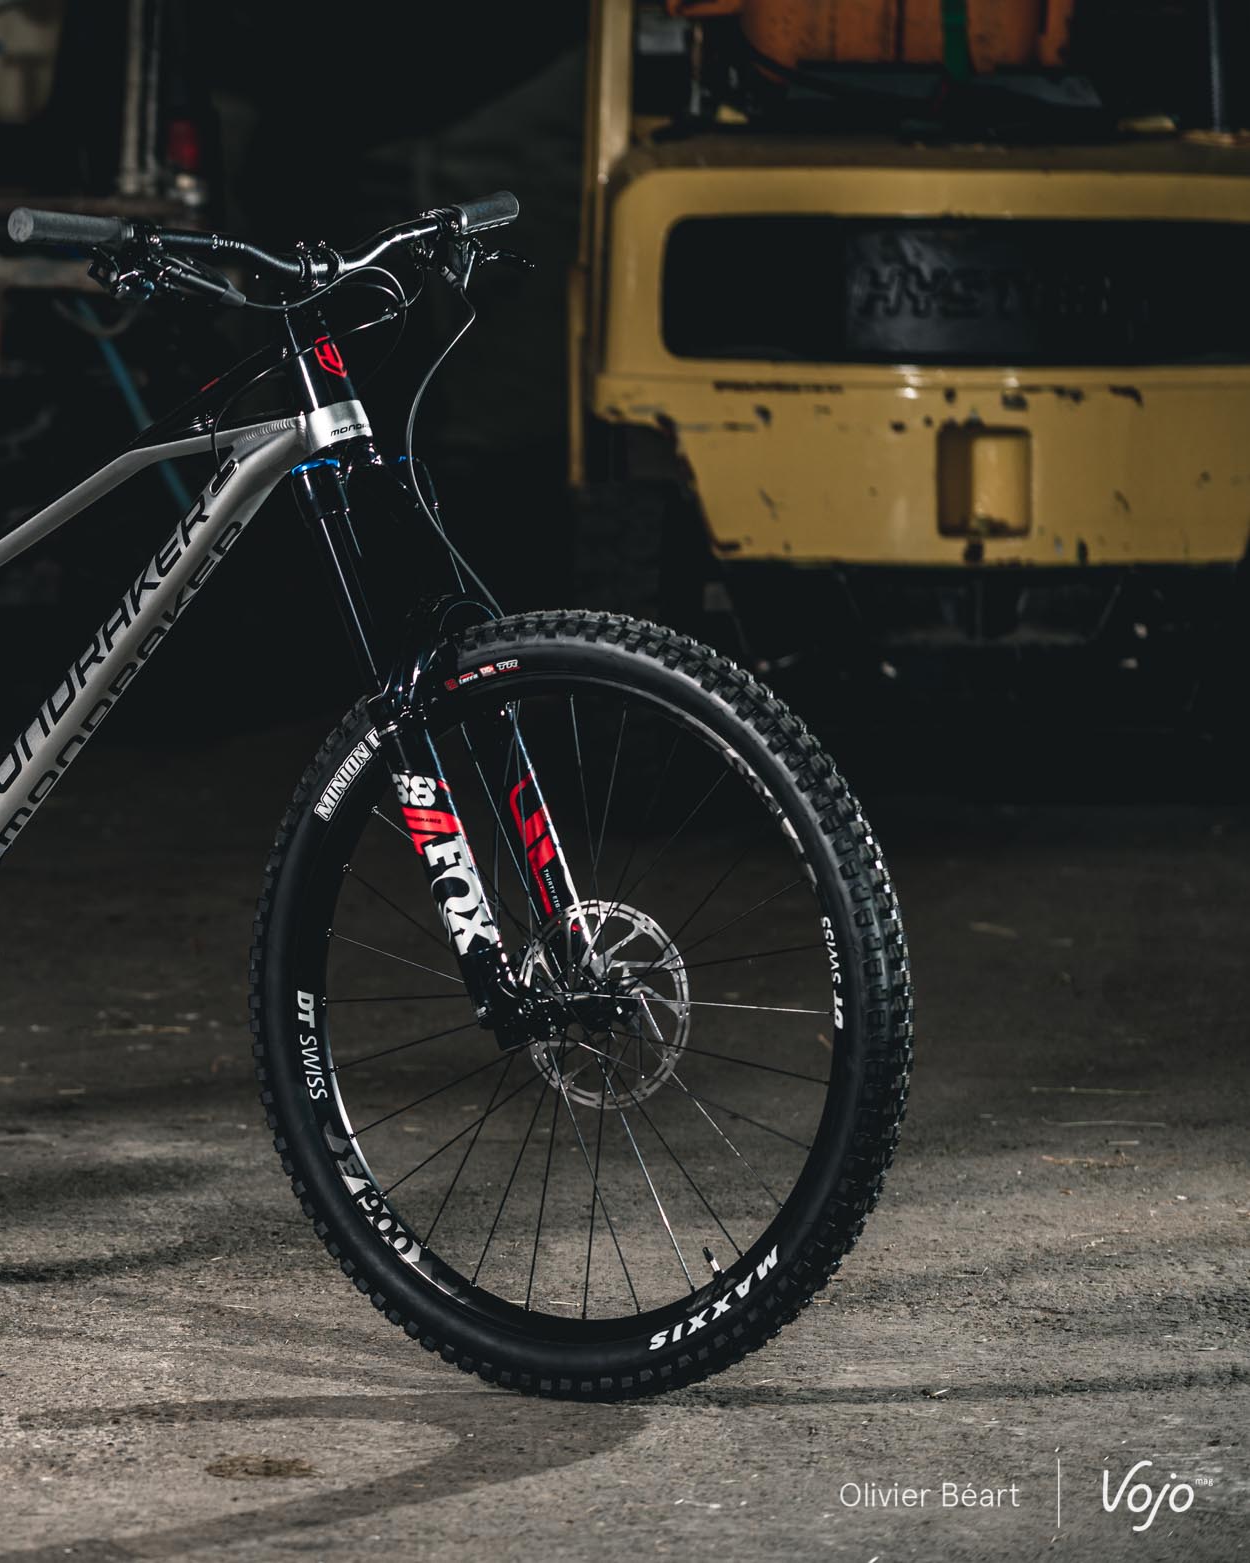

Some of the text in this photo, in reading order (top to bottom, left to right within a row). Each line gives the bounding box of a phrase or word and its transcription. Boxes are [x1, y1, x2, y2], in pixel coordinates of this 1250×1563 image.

[314, 741, 372, 821] MINION
[423, 834, 500, 956] FOX
[543, 868, 556, 894] THIRTY
[820, 915, 842, 985] SWISS
[297, 989, 329, 1101] DT SWISS
[649, 1244, 779, 1351] MAXXIS
